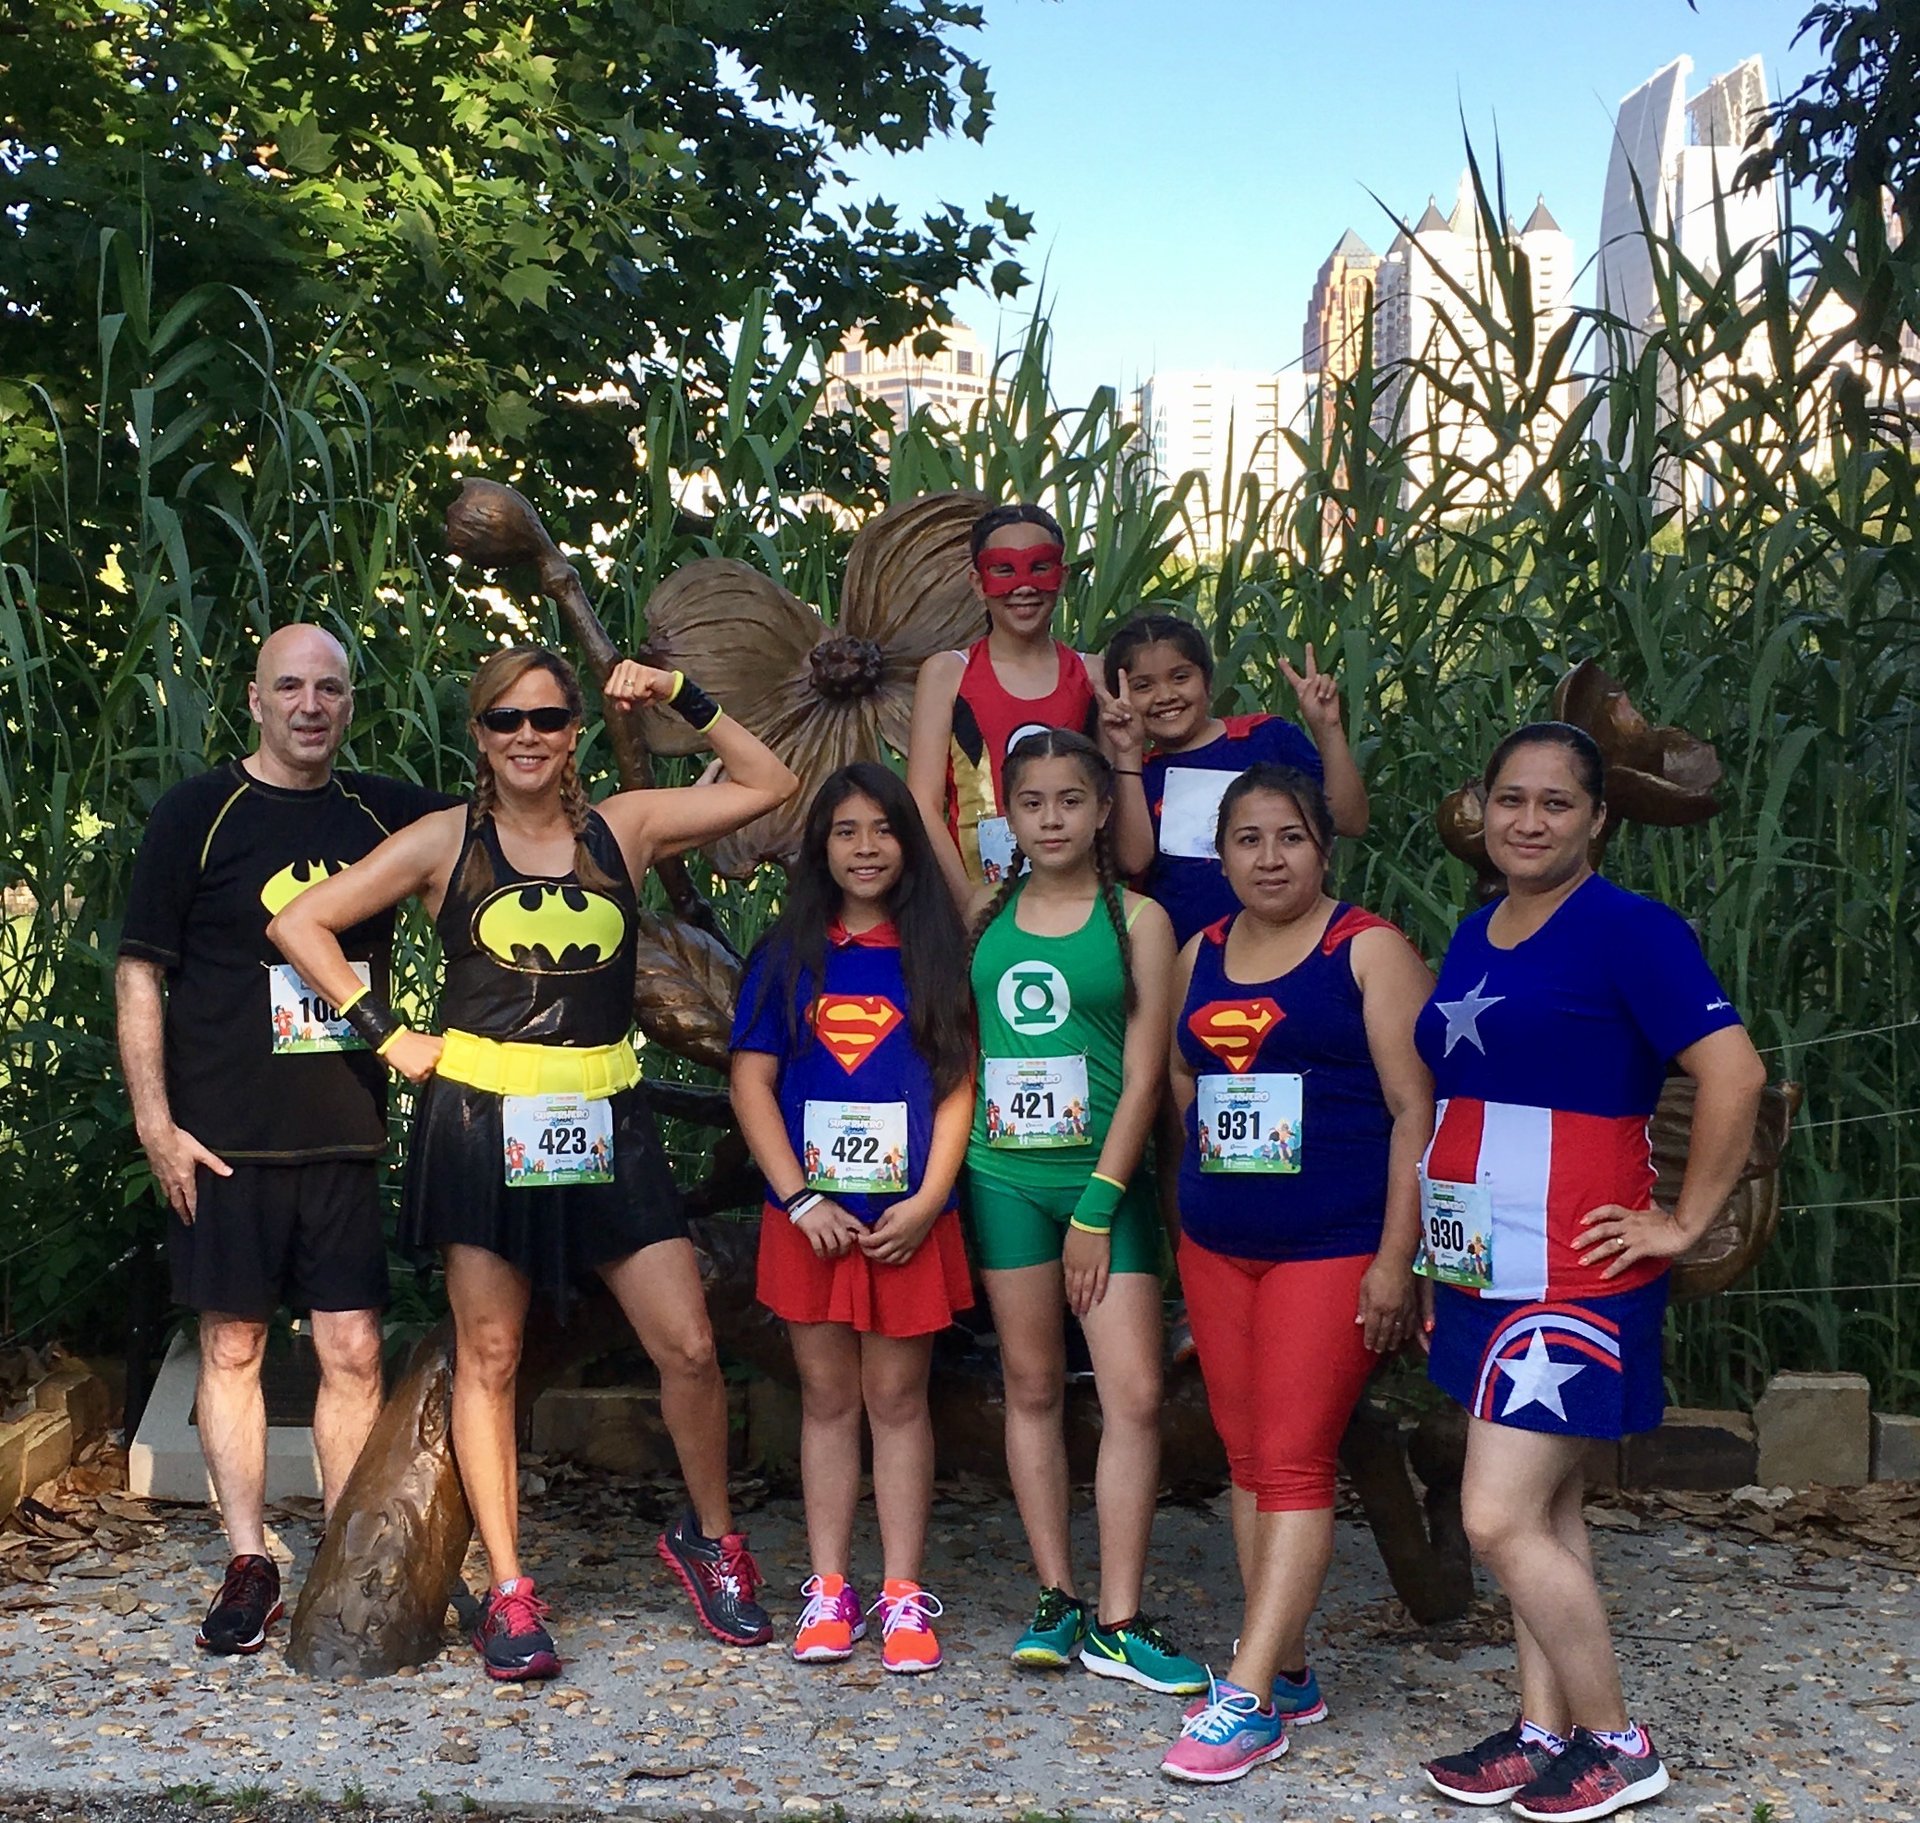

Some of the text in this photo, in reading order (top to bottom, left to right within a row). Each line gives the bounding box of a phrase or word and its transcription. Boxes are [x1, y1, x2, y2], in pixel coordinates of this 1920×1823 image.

[1010, 1092, 1055, 1119] 421
[1217, 1110, 1261, 1141] 931
[539, 1127, 587, 1155] 423
[831, 1136, 880, 1164] 422
[1430, 1217, 1464, 1252] 930
